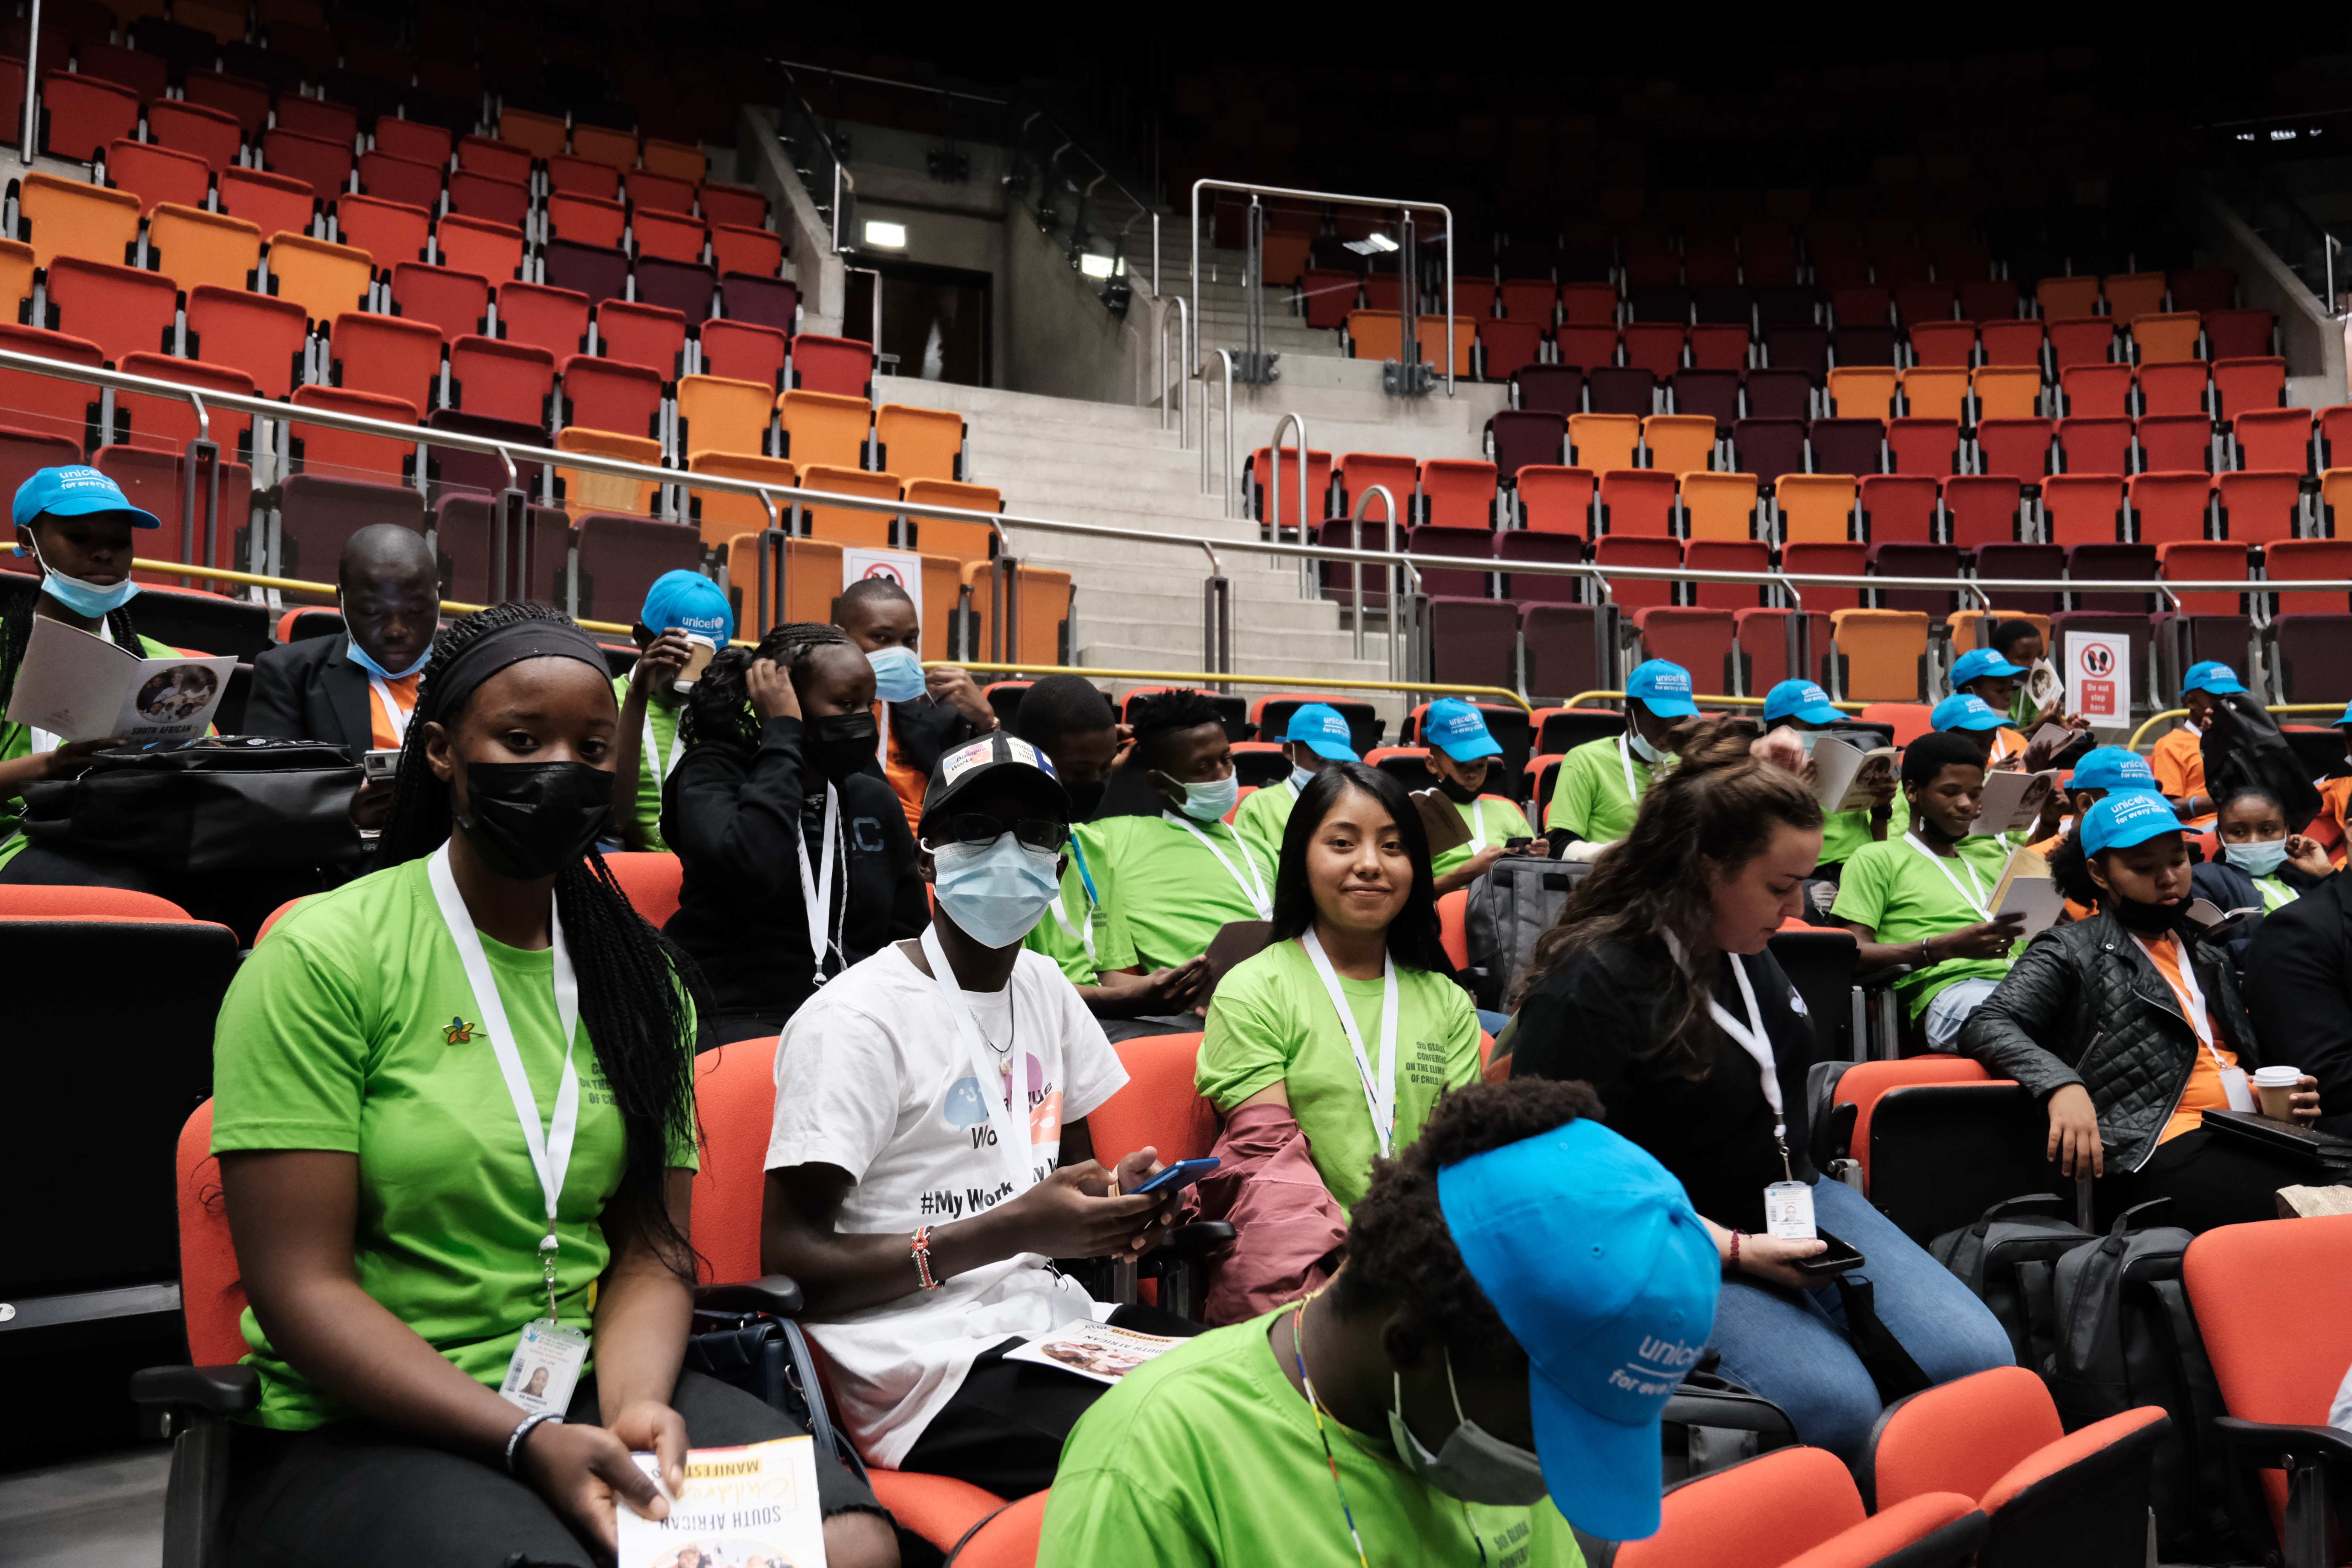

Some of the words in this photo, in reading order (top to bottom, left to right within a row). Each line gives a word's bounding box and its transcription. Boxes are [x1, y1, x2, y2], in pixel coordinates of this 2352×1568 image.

[682, 616, 715, 629] unicef
[2087, 683, 2096, 691] Do
[2090, 694, 2105, 703] step
[2090, 703, 2105, 712] here
[1323, 717, 1344, 726] unice
[1449, 713, 1472, 725] unicef
[132, 726, 158, 735] SOUTH
[159, 724, 193, 734] AFRICAN
[1009, 742, 1034, 754] kinder
[957, 747, 986, 762] Dialogue
[1023, 750, 1035, 759] not
[951, 757, 973, 771] Works
[2111, 795, 2145, 813] unicef
[2116, 816, 2128, 825] for
[2128, 808, 2150, 819] every
[1416, 1041, 1427, 1050] 5th
[1427, 1043, 1446, 1053] GLOBAL
[1417, 1052, 1447, 1064] CONFERENC
[1406, 1062, 1415, 1070] ON
[1416, 1063, 1429, 1072] THE
[1411, 1074, 1419, 1083] OF
[1421, 1075, 1439, 1086] CHILD
[589, 1092, 600, 1104] OF
[920, 1190, 963, 1219] #My
[966, 1182, 1014, 1212] Work
[1084, 1335, 1132, 1348] AFRICAN
[1112, 1329, 1172, 1343] MANIFESTO
[1608, 1369, 1639, 1391] for
[686, 1460, 760, 1478] MANIFEST
[660, 1511, 726, 1531] AFRICAN
[733, 1505, 781, 1528] SOUTH
